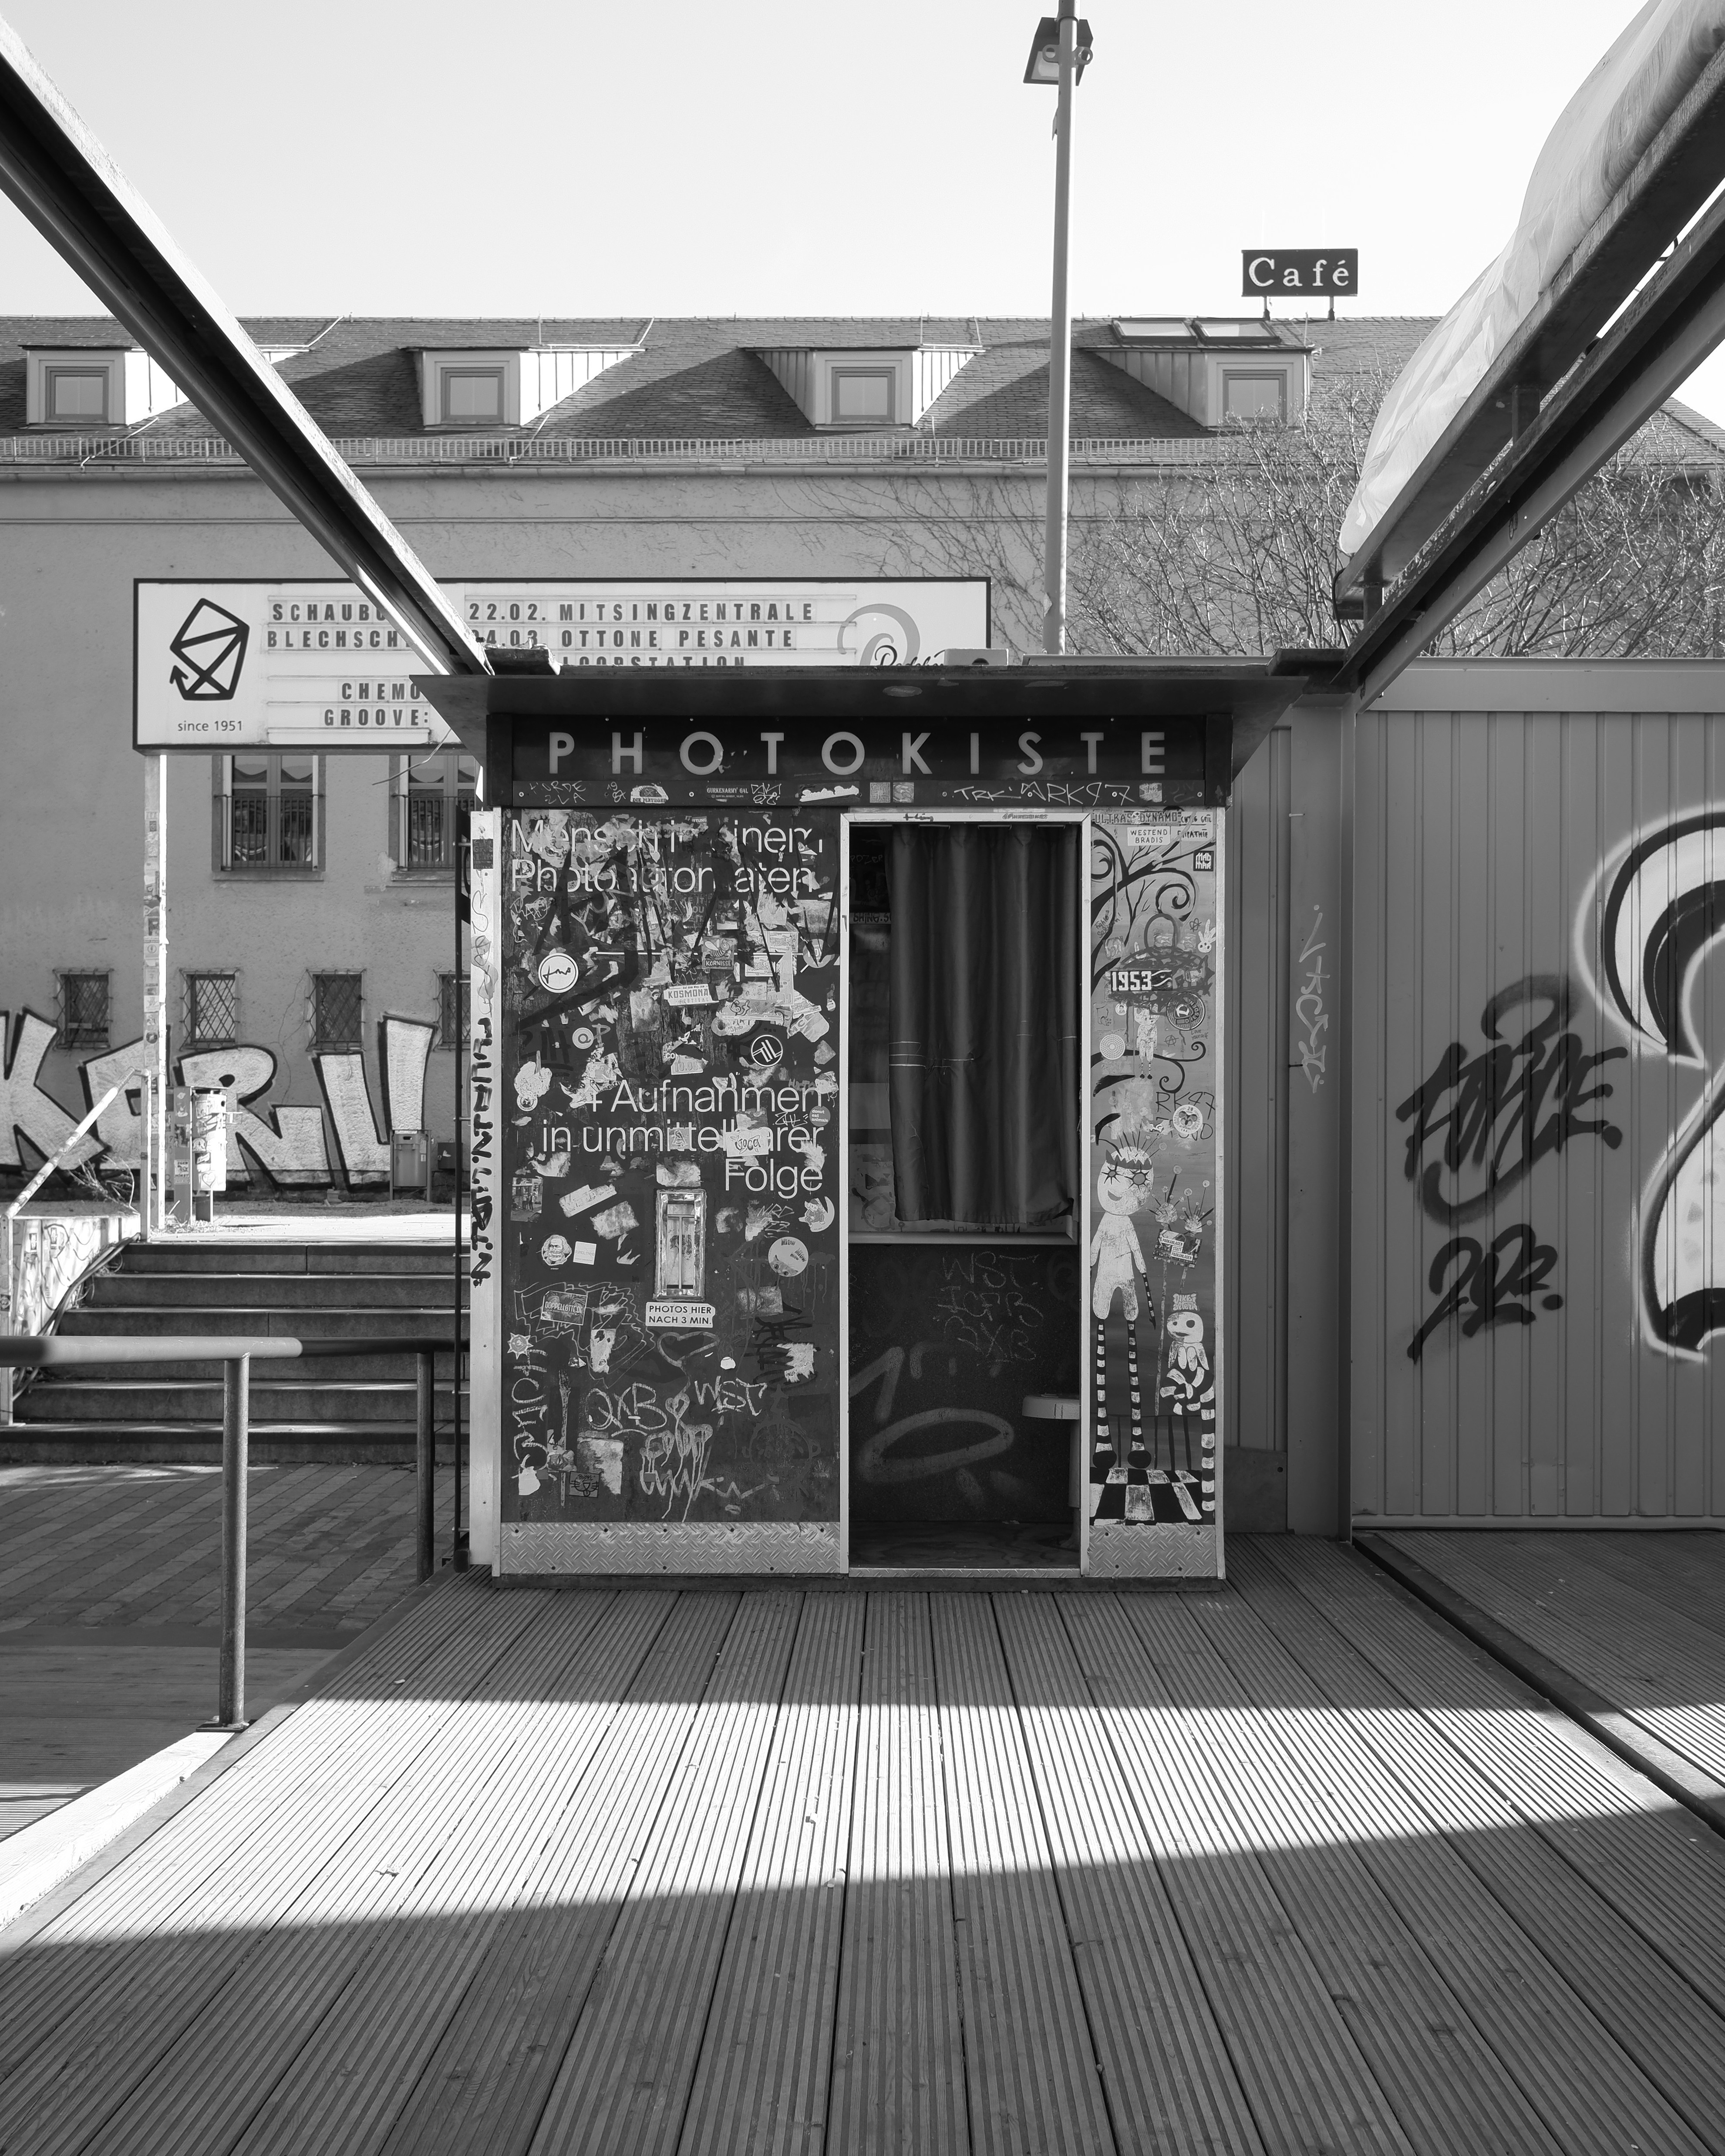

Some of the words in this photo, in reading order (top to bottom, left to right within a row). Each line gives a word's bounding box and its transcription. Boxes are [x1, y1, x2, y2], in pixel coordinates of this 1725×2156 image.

[1248, 257, 1349, 287] Café
[469, 603, 546, 621] 22.02.
[559, 603, 812, 621] MITSINGZENTRALE
[267, 630, 410, 648] BLECHSCH
[471, 629, 538, 647] 4.03
[562, 629, 658, 648] OTTONE
[679, 629, 792, 648] PESANTE
[177, 719, 210, 732] since
[214, 720, 243, 732] 1951
[324, 709, 429, 726] GROOVE:
[549, 731, 1166, 775] PHOTOKISTE
[1112, 971, 1152, 991] 1953
[543, 1119, 571, 1152] in
[725, 1158, 823, 1199] Folge
[649, 1305, 687, 1314] PHOTOS
[649, 1316, 678, 1324] NACH
[681, 1316, 687, 1324] 3
[689, 1317, 712, 1325] MIN.
